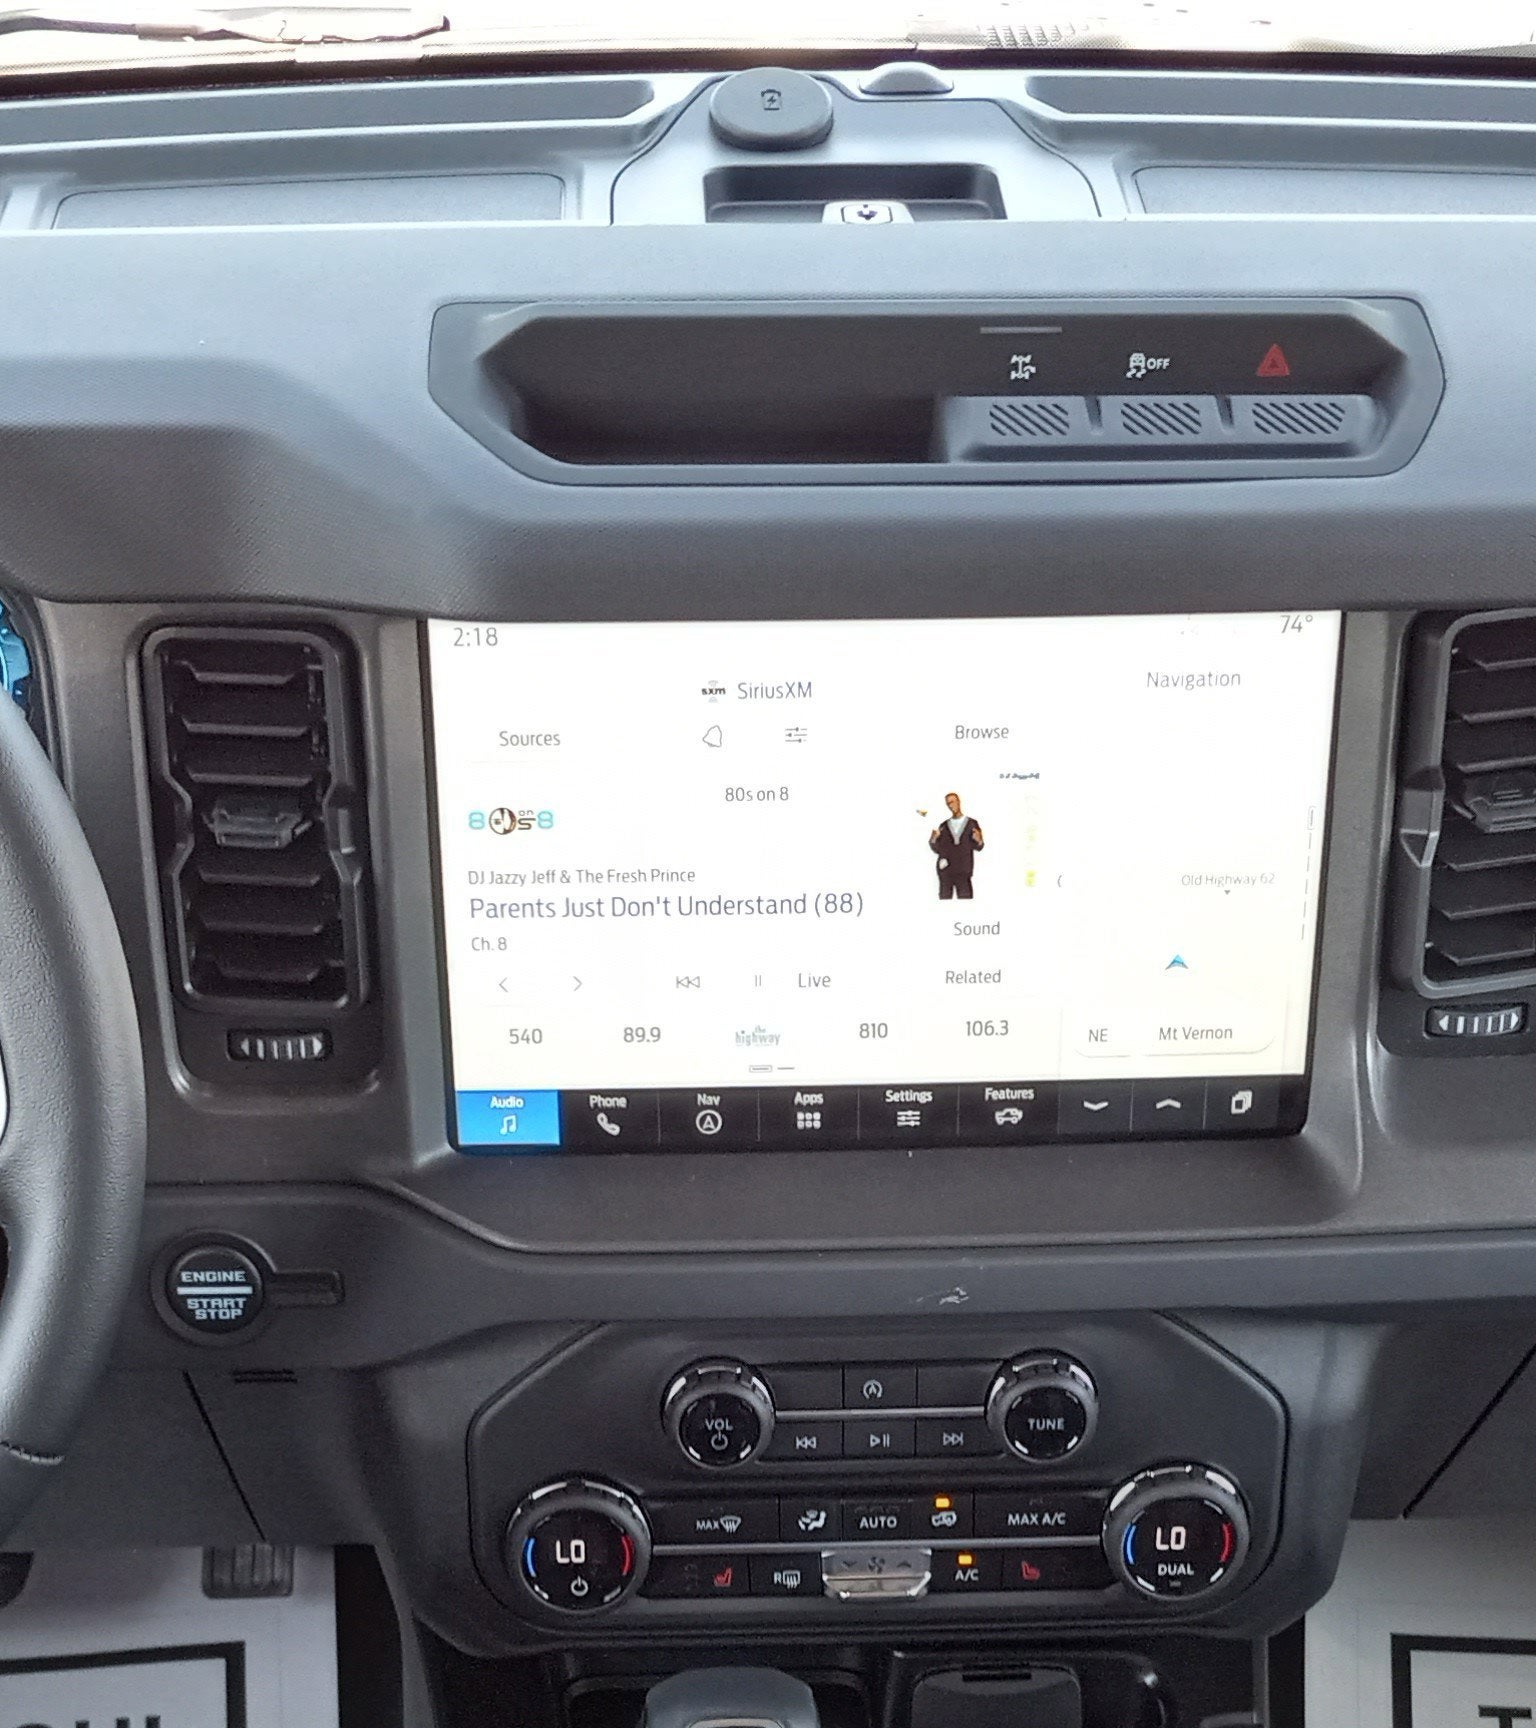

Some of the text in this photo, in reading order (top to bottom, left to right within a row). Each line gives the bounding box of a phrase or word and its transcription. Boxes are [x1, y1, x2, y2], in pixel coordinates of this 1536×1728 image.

[1147, 357, 1171, 371] OFF
[1280, 614, 1314, 634] 74°
[453, 627, 499, 648] 2:18
[1146, 671, 1241, 691] Navigation
[737, 682, 813, 700] SiriusXM
[499, 731, 561, 747] Sources
[955, 724, 1010, 740] Browse
[725, 786, 790, 802] 80s on 8
[468, 867, 696, 887] DJ Jazzy Jeff & The Fresh Prince
[470, 891, 864, 919] Parents Just Don't Understand (88)
[954, 921, 1001, 936] Sound
[471, 936, 508, 952] Ch. 8
[798, 972, 832, 989] Live
[945, 970, 1002, 985] Related
[509, 1027, 543, 1045] 540
[623, 1026, 662, 1044] 89.9
[859, 1022, 888, 1040] 810
[965, 1020, 1009, 1037] 106.3
[1088, 1028, 1109, 1042] NE
[1159, 1026, 1233, 1041] Mt Vernon
[490, 1095, 524, 1109] Audio
[589, 1094, 627, 1109] Phone
[697, 1093, 720, 1107] Nav
[794, 1092, 824, 1108] Apps
[885, 1089, 933, 1104] Settings
[984, 1087, 1035, 1102] Features
[181, 1271, 246, 1282] ENGINE
[186, 1298, 247, 1309] START
[195, 1309, 243, 1320] STOP
[705, 1419, 733, 1431] VOL
[1027, 1418, 1064, 1431] TUNE
[696, 1519, 720, 1531] MAX
[859, 1516, 898, 1530] AUTO
[1007, 1512, 1066, 1526] MAX A/C
[1155, 1526, 1187, 1551] LO
[555, 1540, 586, 1564] LO
[955, 1569, 979, 1582] A/C
[1157, 1563, 1195, 1576] DUAL
